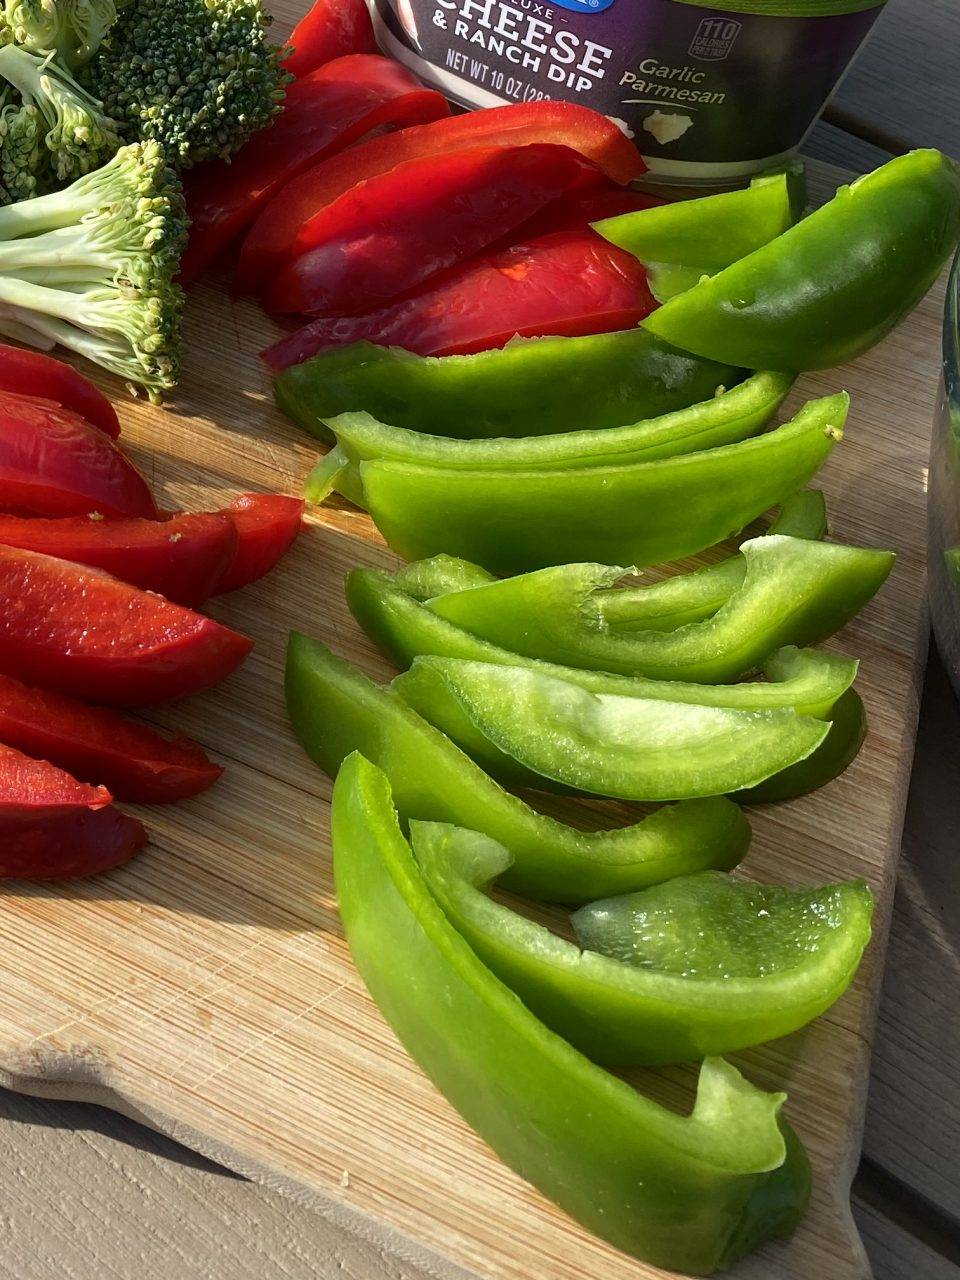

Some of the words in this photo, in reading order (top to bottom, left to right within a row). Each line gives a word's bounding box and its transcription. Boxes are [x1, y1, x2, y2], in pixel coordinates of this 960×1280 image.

[703, 20, 737, 40] 110
[432, 9, 448, 30] &
[454, 19, 540, 72] RANCH
[547, 63, 593, 93] DIP
[445, 48, 467, 73] NET
[470, 60, 489, 82] WT
[491, 70, 504, 90] 10
[505, 77, 523, 99] OZ
[640, 58, 705, 83] Garlic
[618, 71, 726, 104] Parmesan
